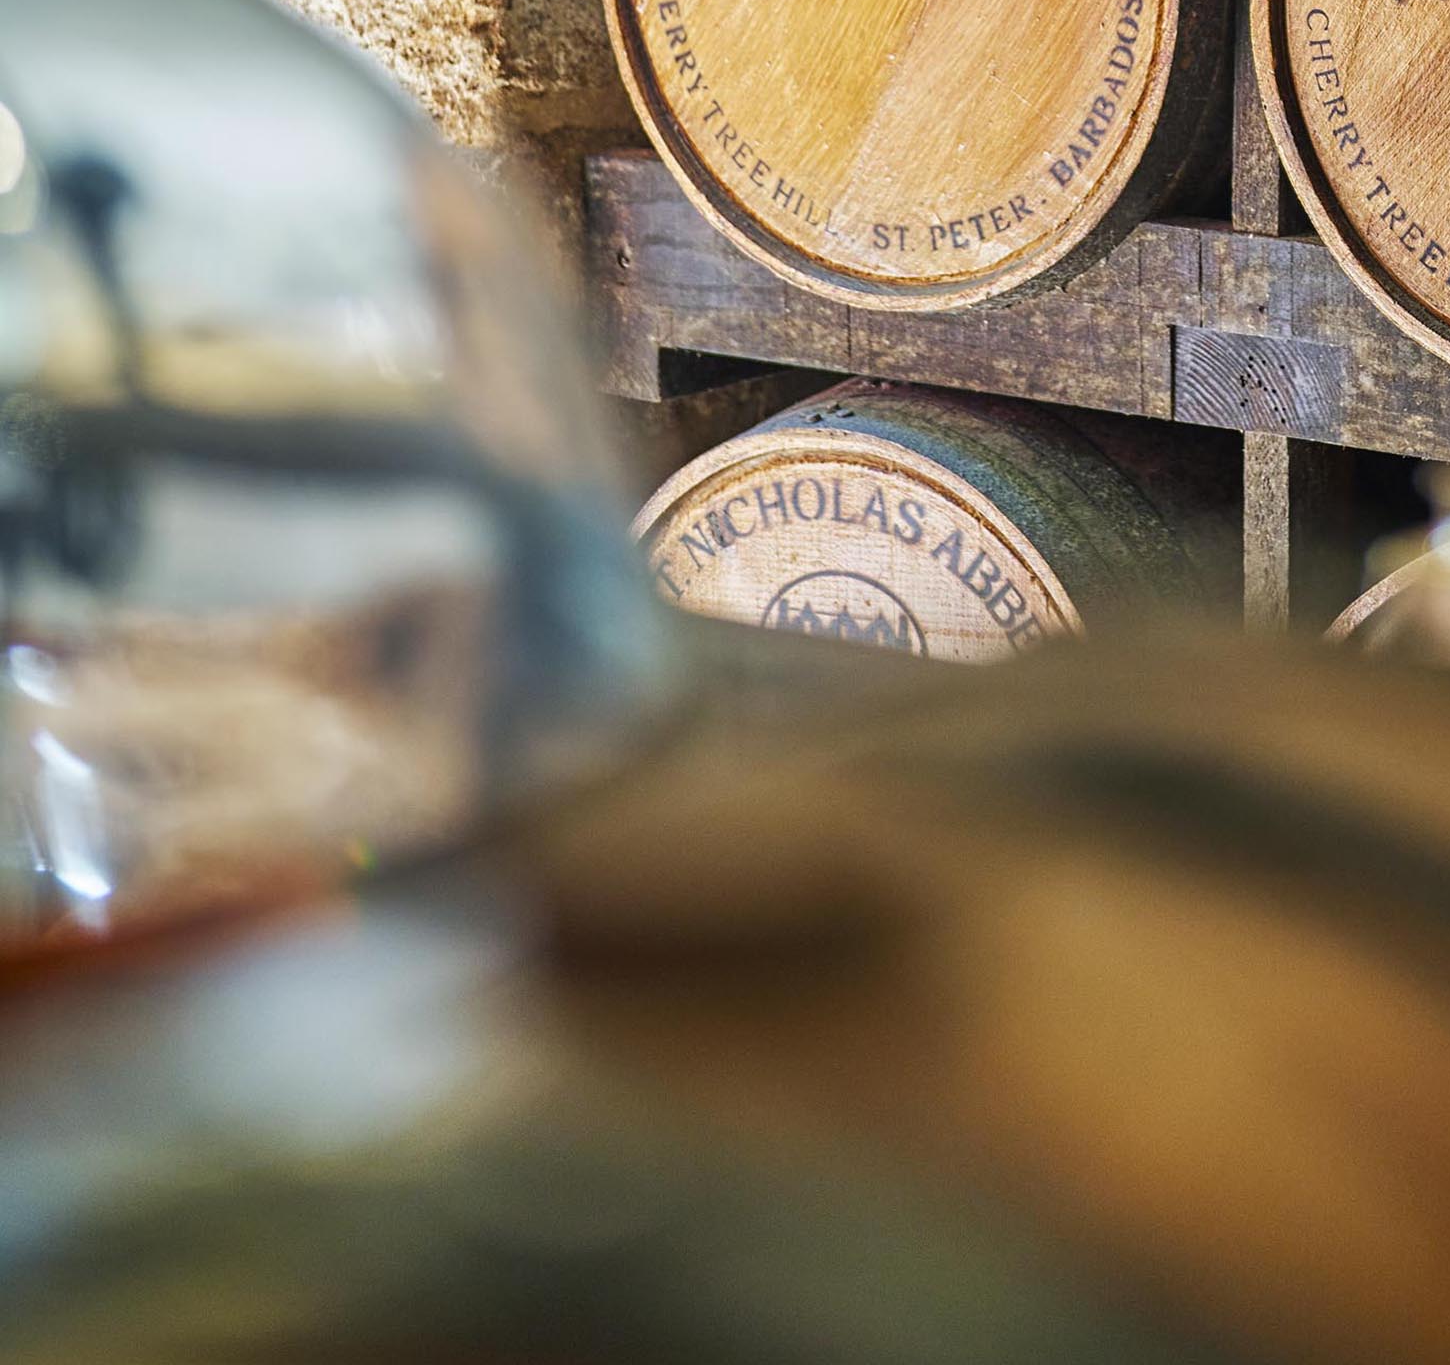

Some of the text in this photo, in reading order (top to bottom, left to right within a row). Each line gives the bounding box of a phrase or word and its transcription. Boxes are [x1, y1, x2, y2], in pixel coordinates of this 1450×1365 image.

[703, 97, 770, 190] TREE
[772, 178, 838, 236] HILL
[873, 223, 915, 253] ST.
[1306, 8, 1371, 172] CHERRY
[1368, 175, 1443, 273] TREE
[655, 478, 1043, 655] T. NICHOLAS ABBE
